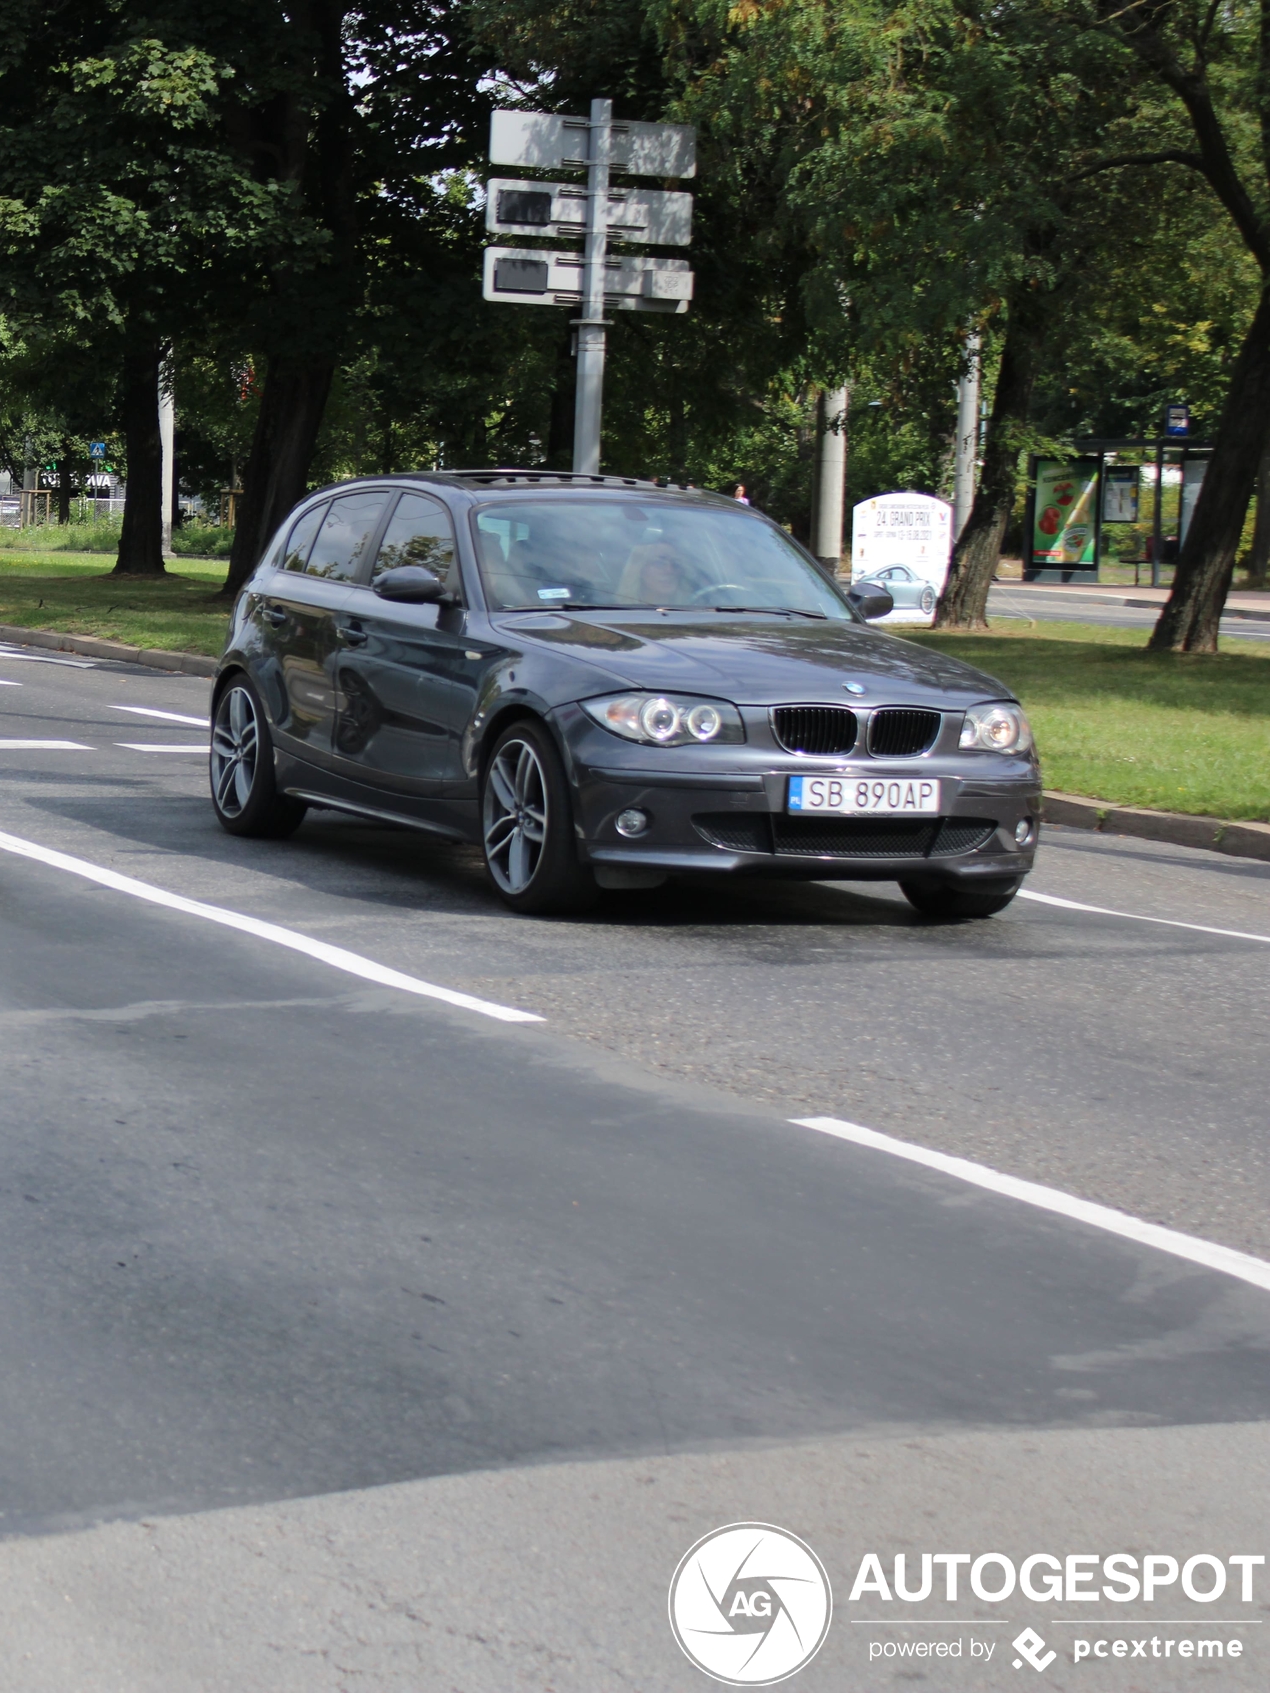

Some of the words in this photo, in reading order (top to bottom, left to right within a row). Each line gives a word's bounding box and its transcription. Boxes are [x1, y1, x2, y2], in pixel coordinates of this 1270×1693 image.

[890, 511, 913, 527] GRAND
[915, 511, 931, 527] PRIX
[790, 796, 801, 805] PL
[808, 780, 843, 807] SB
[854, 782, 933, 809] 890AP
